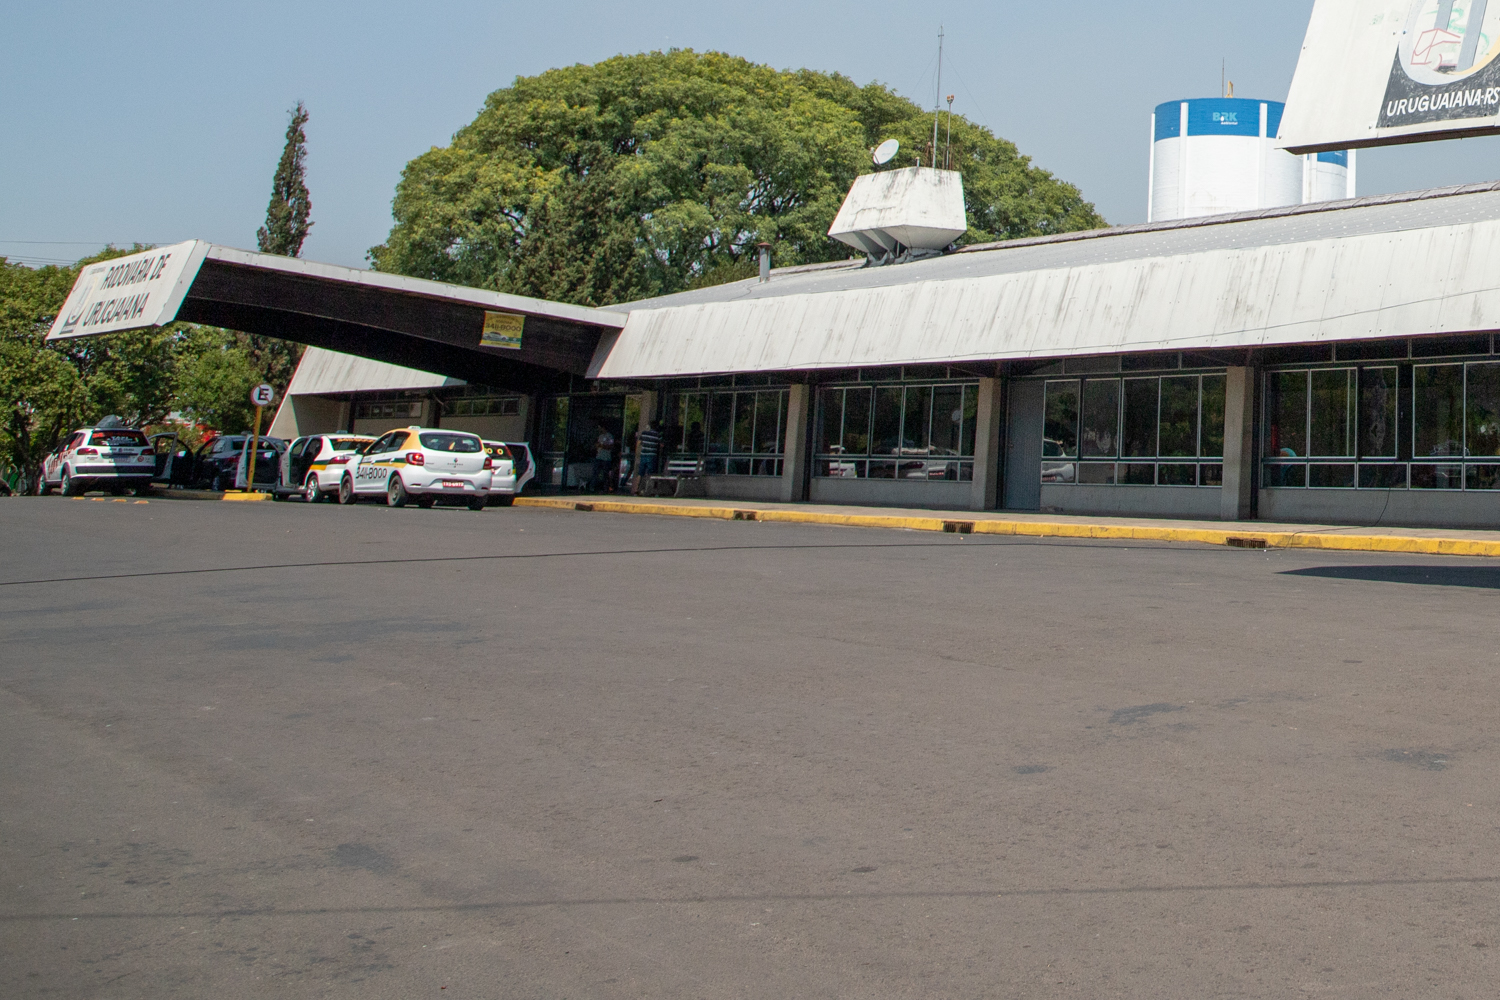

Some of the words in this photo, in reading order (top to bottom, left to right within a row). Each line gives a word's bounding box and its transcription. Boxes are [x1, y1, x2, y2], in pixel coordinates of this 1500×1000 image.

[1212, 111, 1238, 121] BRK
[149, 253, 172, 281] DE
[82, 292, 150, 327] URUGUAIANA
